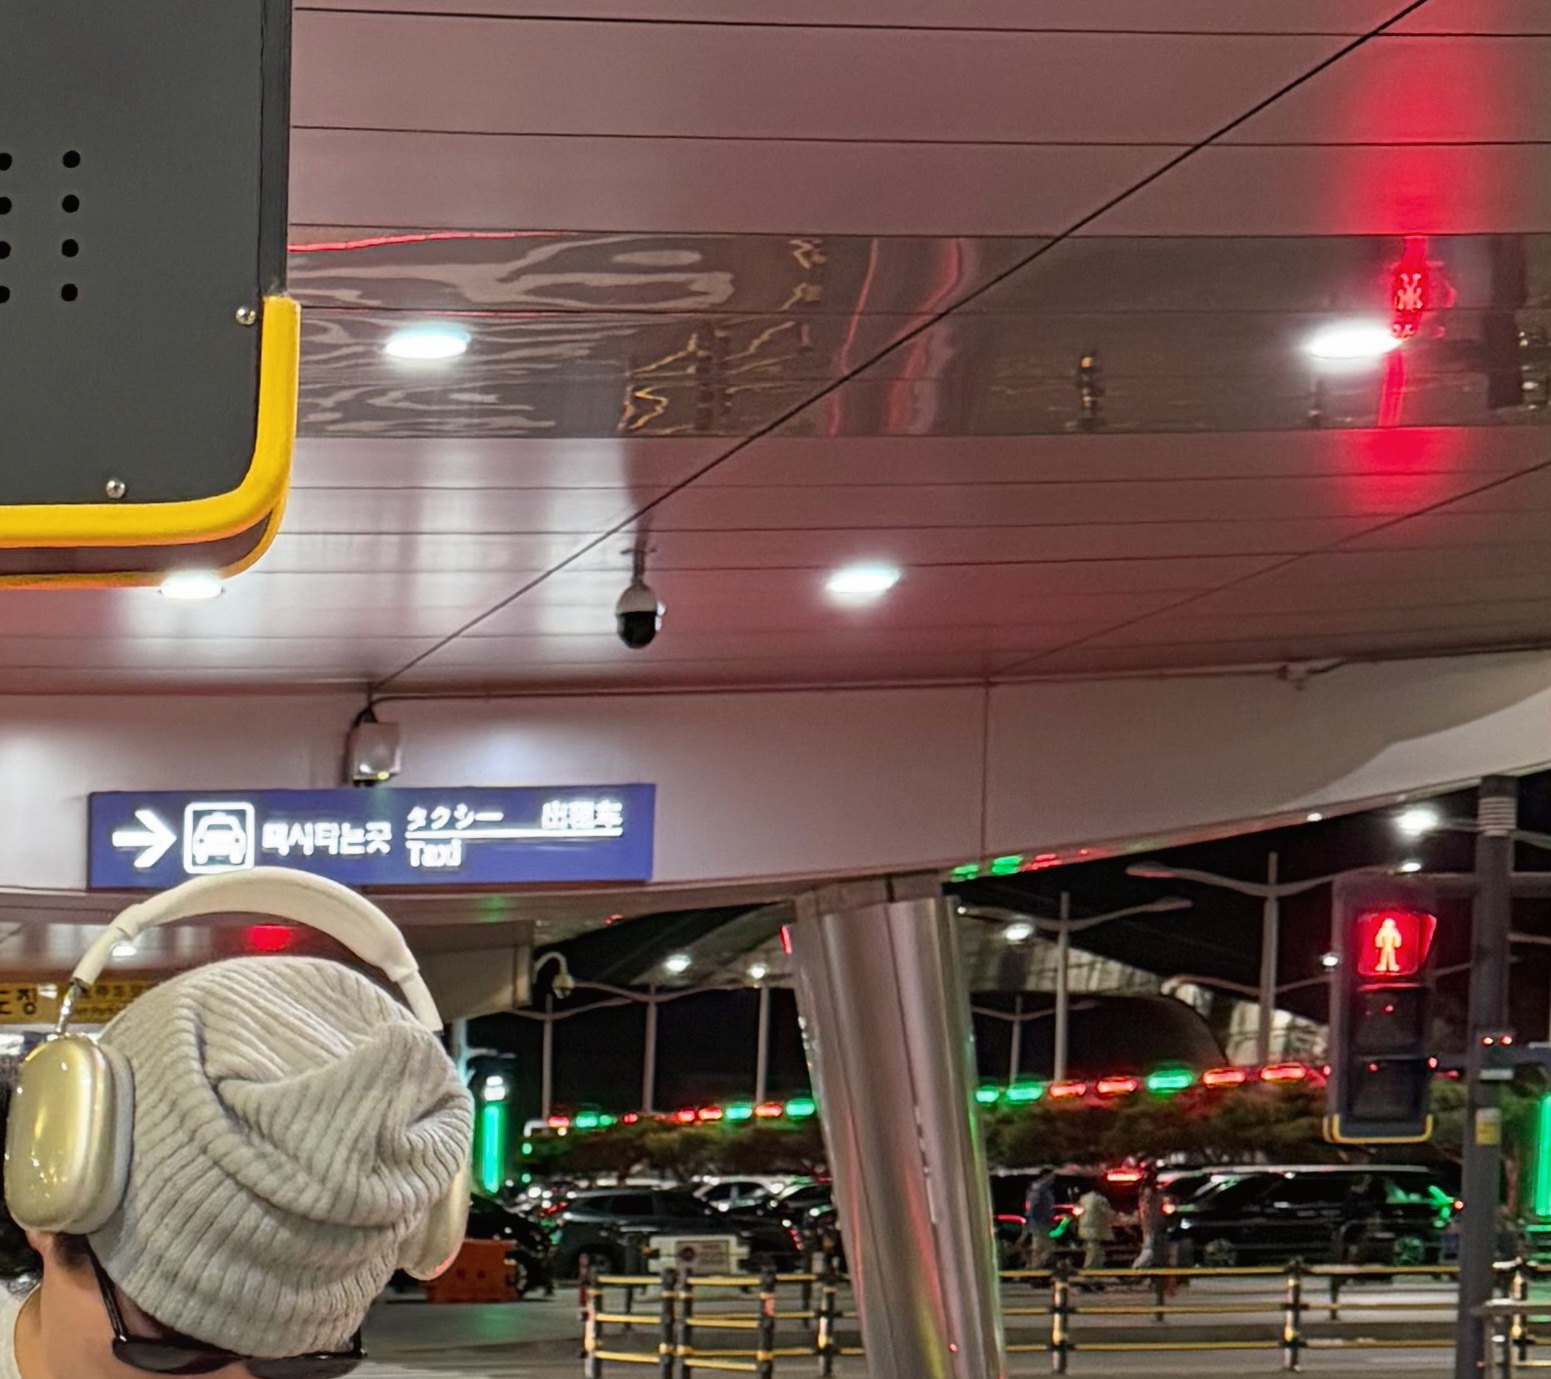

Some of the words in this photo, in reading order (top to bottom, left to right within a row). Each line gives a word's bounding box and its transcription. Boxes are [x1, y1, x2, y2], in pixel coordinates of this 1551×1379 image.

[406, 803, 504, 831] タクシー
[408, 839, 463, 867] Taxi
